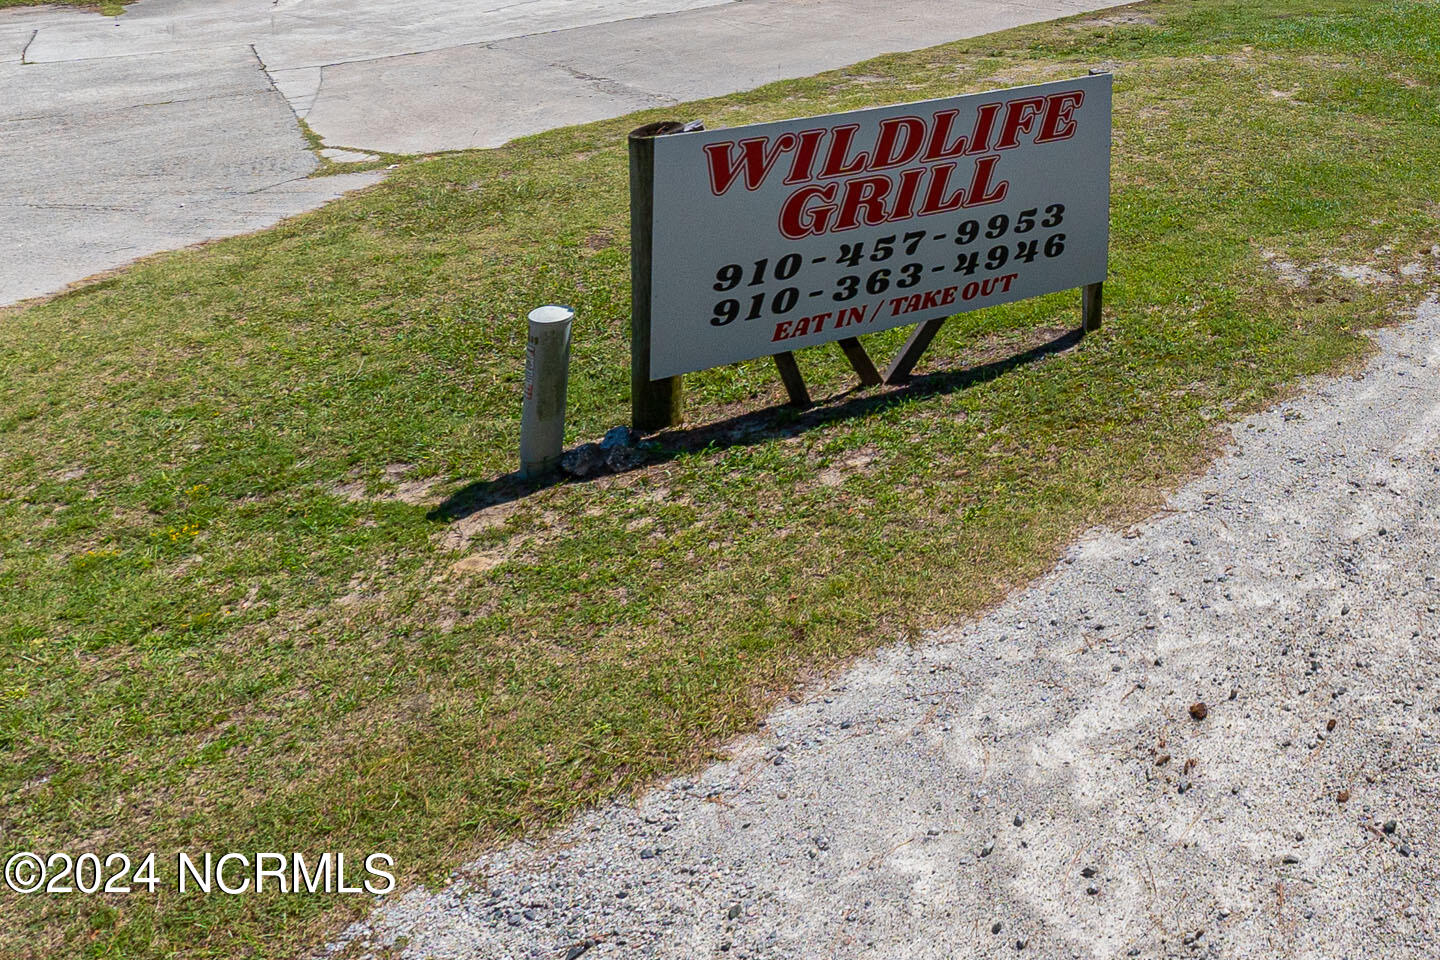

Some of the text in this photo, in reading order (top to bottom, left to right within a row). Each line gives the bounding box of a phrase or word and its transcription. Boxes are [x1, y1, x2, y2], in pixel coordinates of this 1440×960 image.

[703, 89, 1085, 197] WILDLIFE
[778, 154, 1010, 240] GRILL
[709, 234, 1067, 328] 910-363-4946
[712, 204, 1066, 292] 910-457-9953
[770, 312, 833, 343] EAT
[835, 304, 868, 326] IN
[888, 286, 959, 317] TAKE
[961, 273, 1019, 297] OUT
